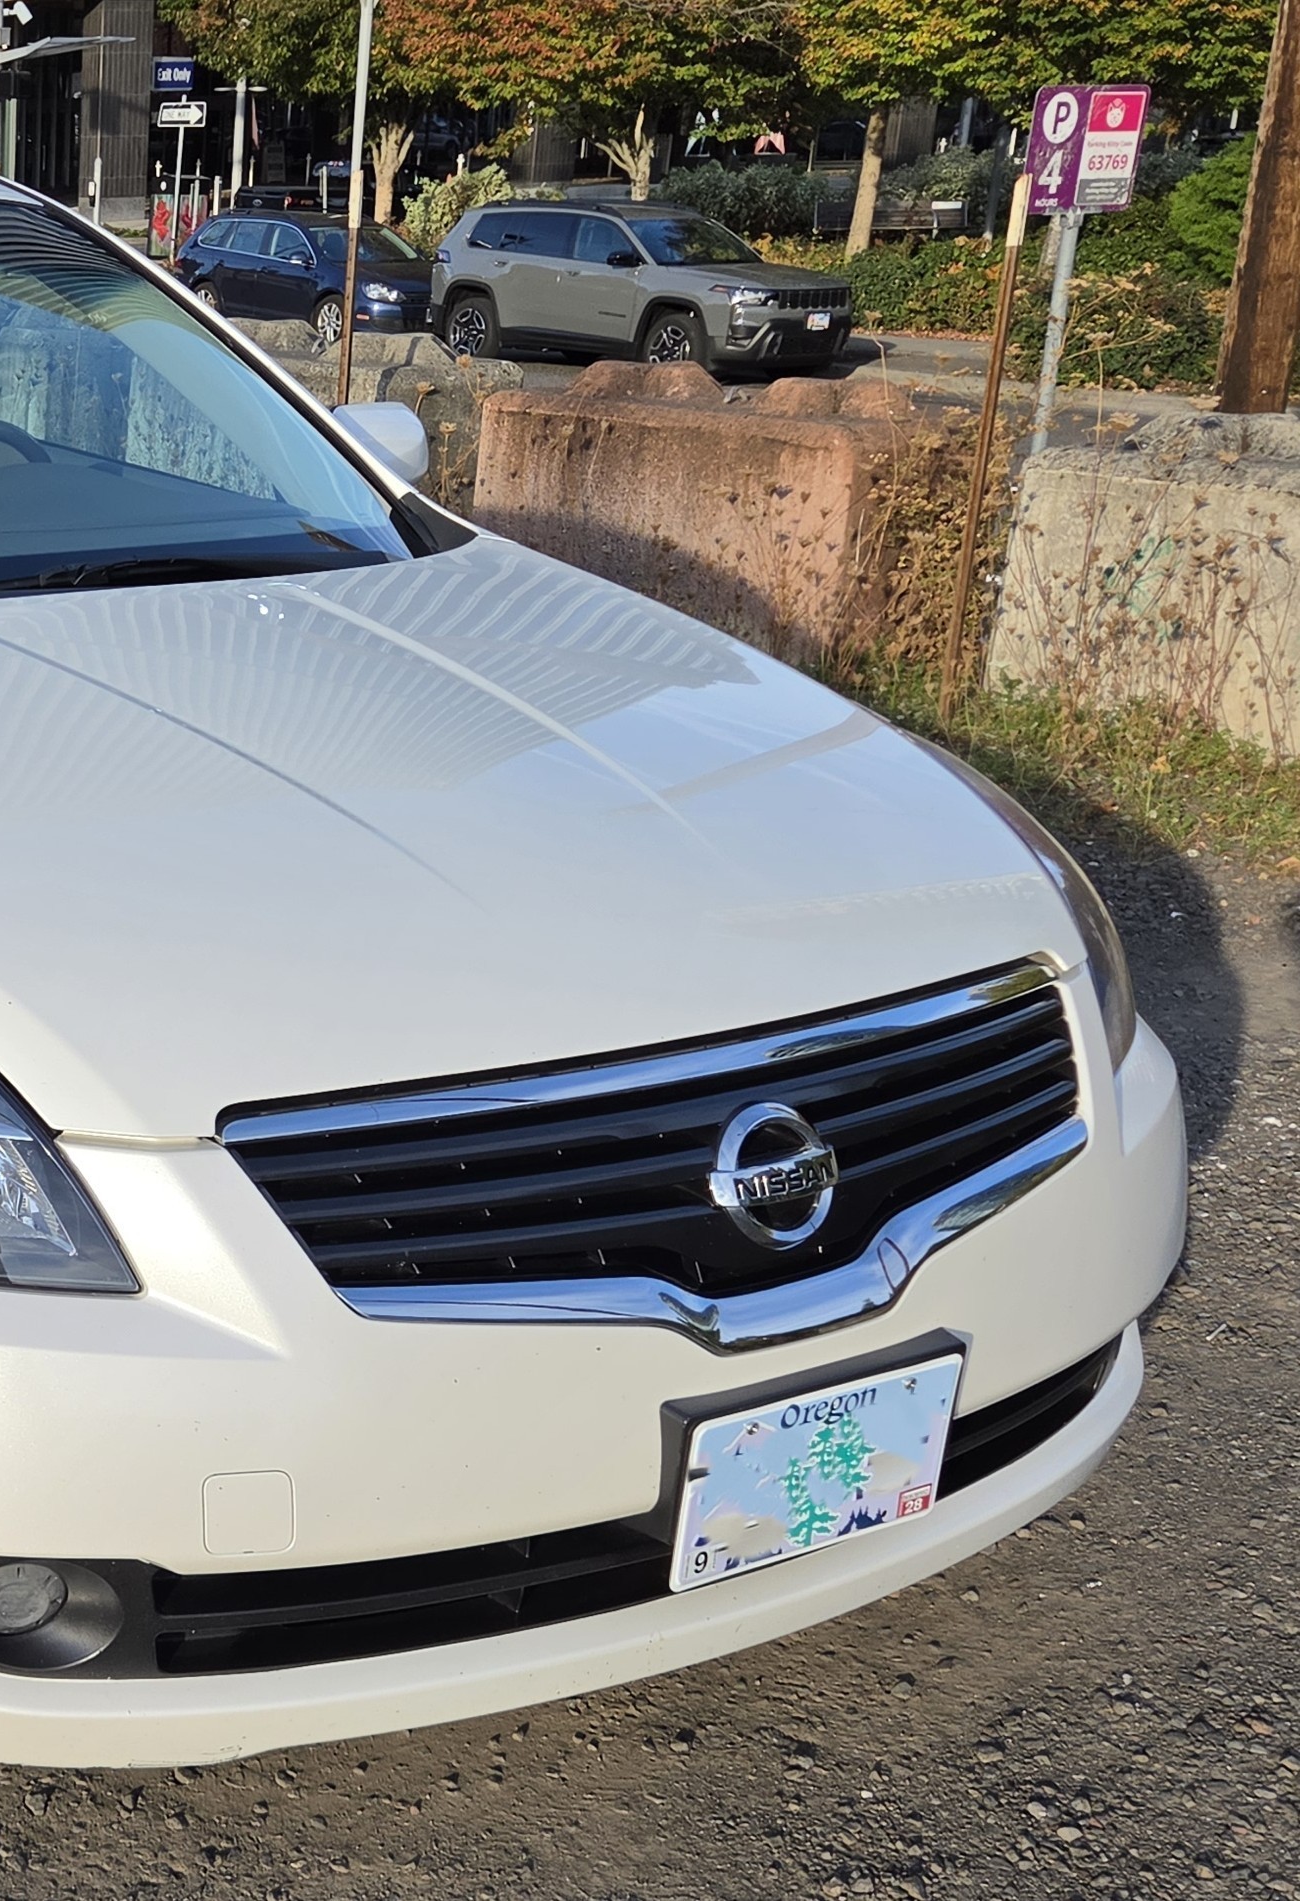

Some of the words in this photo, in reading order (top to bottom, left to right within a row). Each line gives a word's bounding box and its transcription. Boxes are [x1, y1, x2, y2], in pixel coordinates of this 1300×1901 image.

[157, 68, 172, 82] Exit
[173, 67, 191, 83] Only
[1052, 101, 1071, 135] P
[1038, 150, 1063, 194] 4
[1087, 154, 1128, 172] 63769
[1034, 198, 1058, 207] HOURS
[733, 1157, 836, 1200] NISSAN
[780, 1386, 877, 1430] Oregon
[904, 1497, 923, 1515] 28
[694, 1551, 708, 1574] 9
